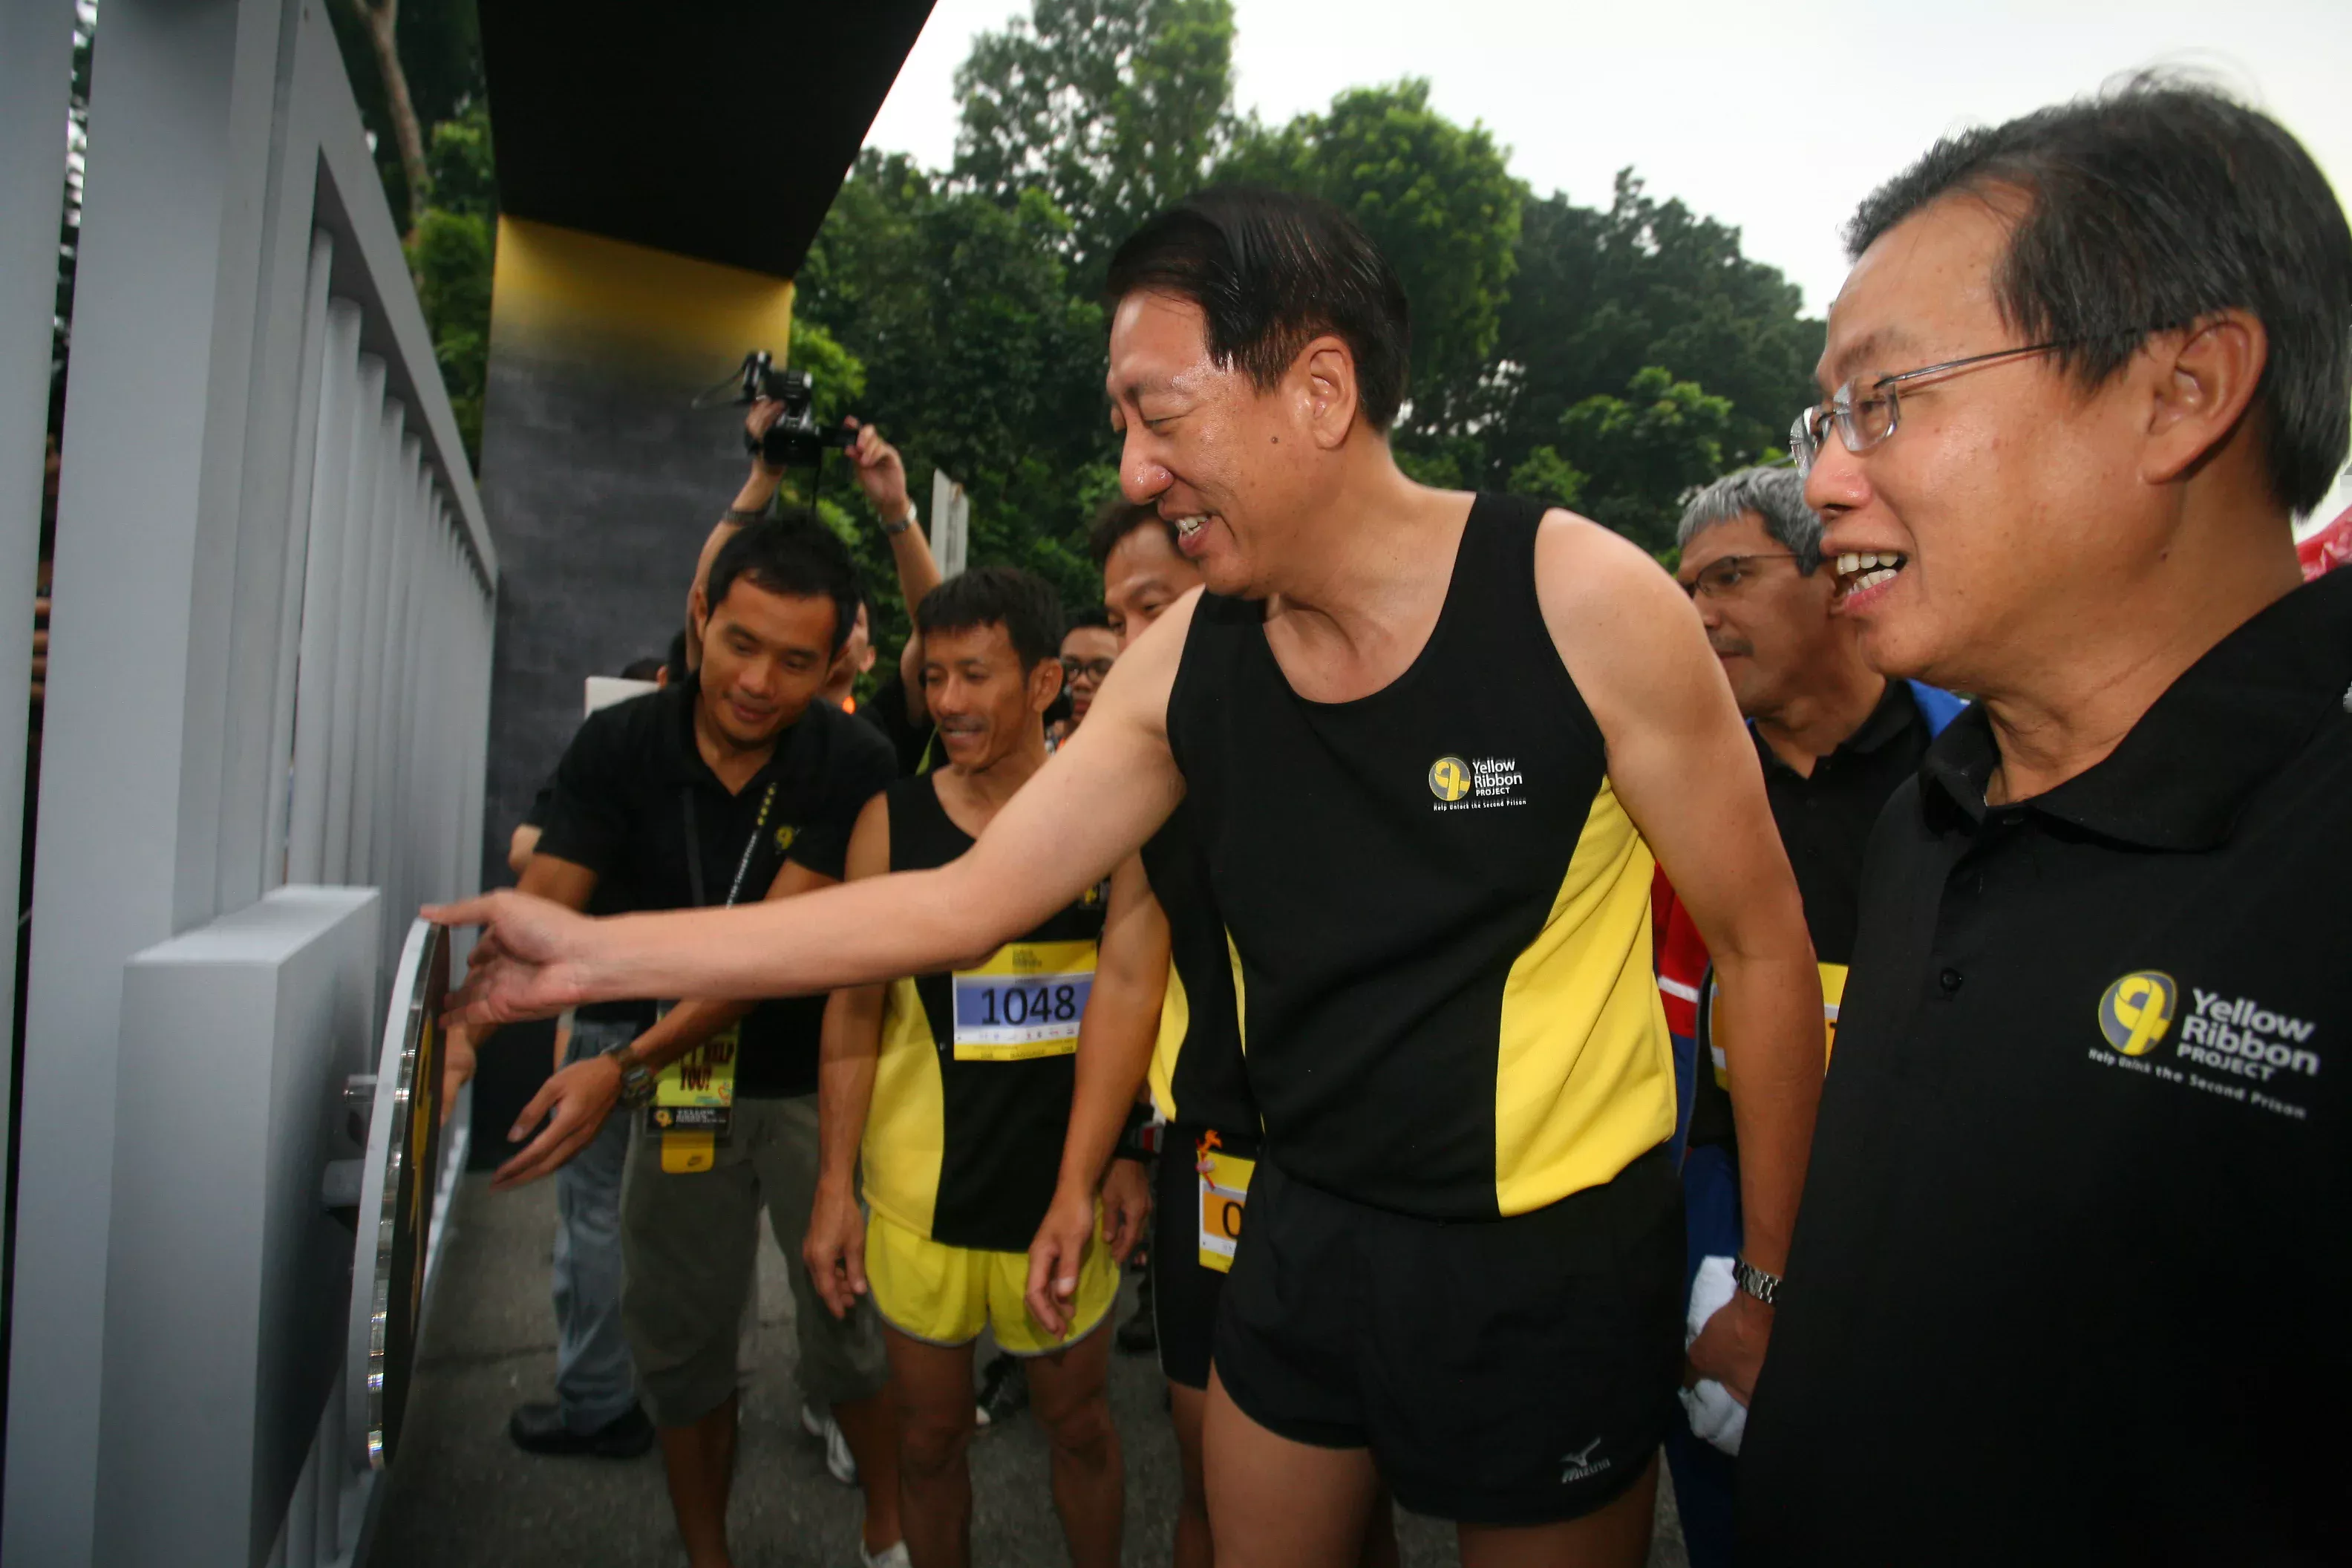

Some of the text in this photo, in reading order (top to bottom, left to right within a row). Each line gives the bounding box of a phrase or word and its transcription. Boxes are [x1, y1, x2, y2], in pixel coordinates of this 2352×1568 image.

[1472, 758, 1515, 774] Yellow
[1474, 772, 1523, 788] Ribbon
[1433, 798, 1526, 811] Help Unlock the Second Prison
[1476, 787, 1510, 797] PROJECT
[981, 984, 1076, 1026] 1048
[2192, 987, 2316, 1043] Yellow
[2176, 1042, 2276, 1082] PROJECT
[2180, 1013, 2321, 1076] Ribbon
[2088, 1047, 2115, 1067] Help
[2156, 1064, 2183, 1082] the
[2189, 1074, 2246, 1101] Second
[2251, 1089, 2307, 1120] Prison
